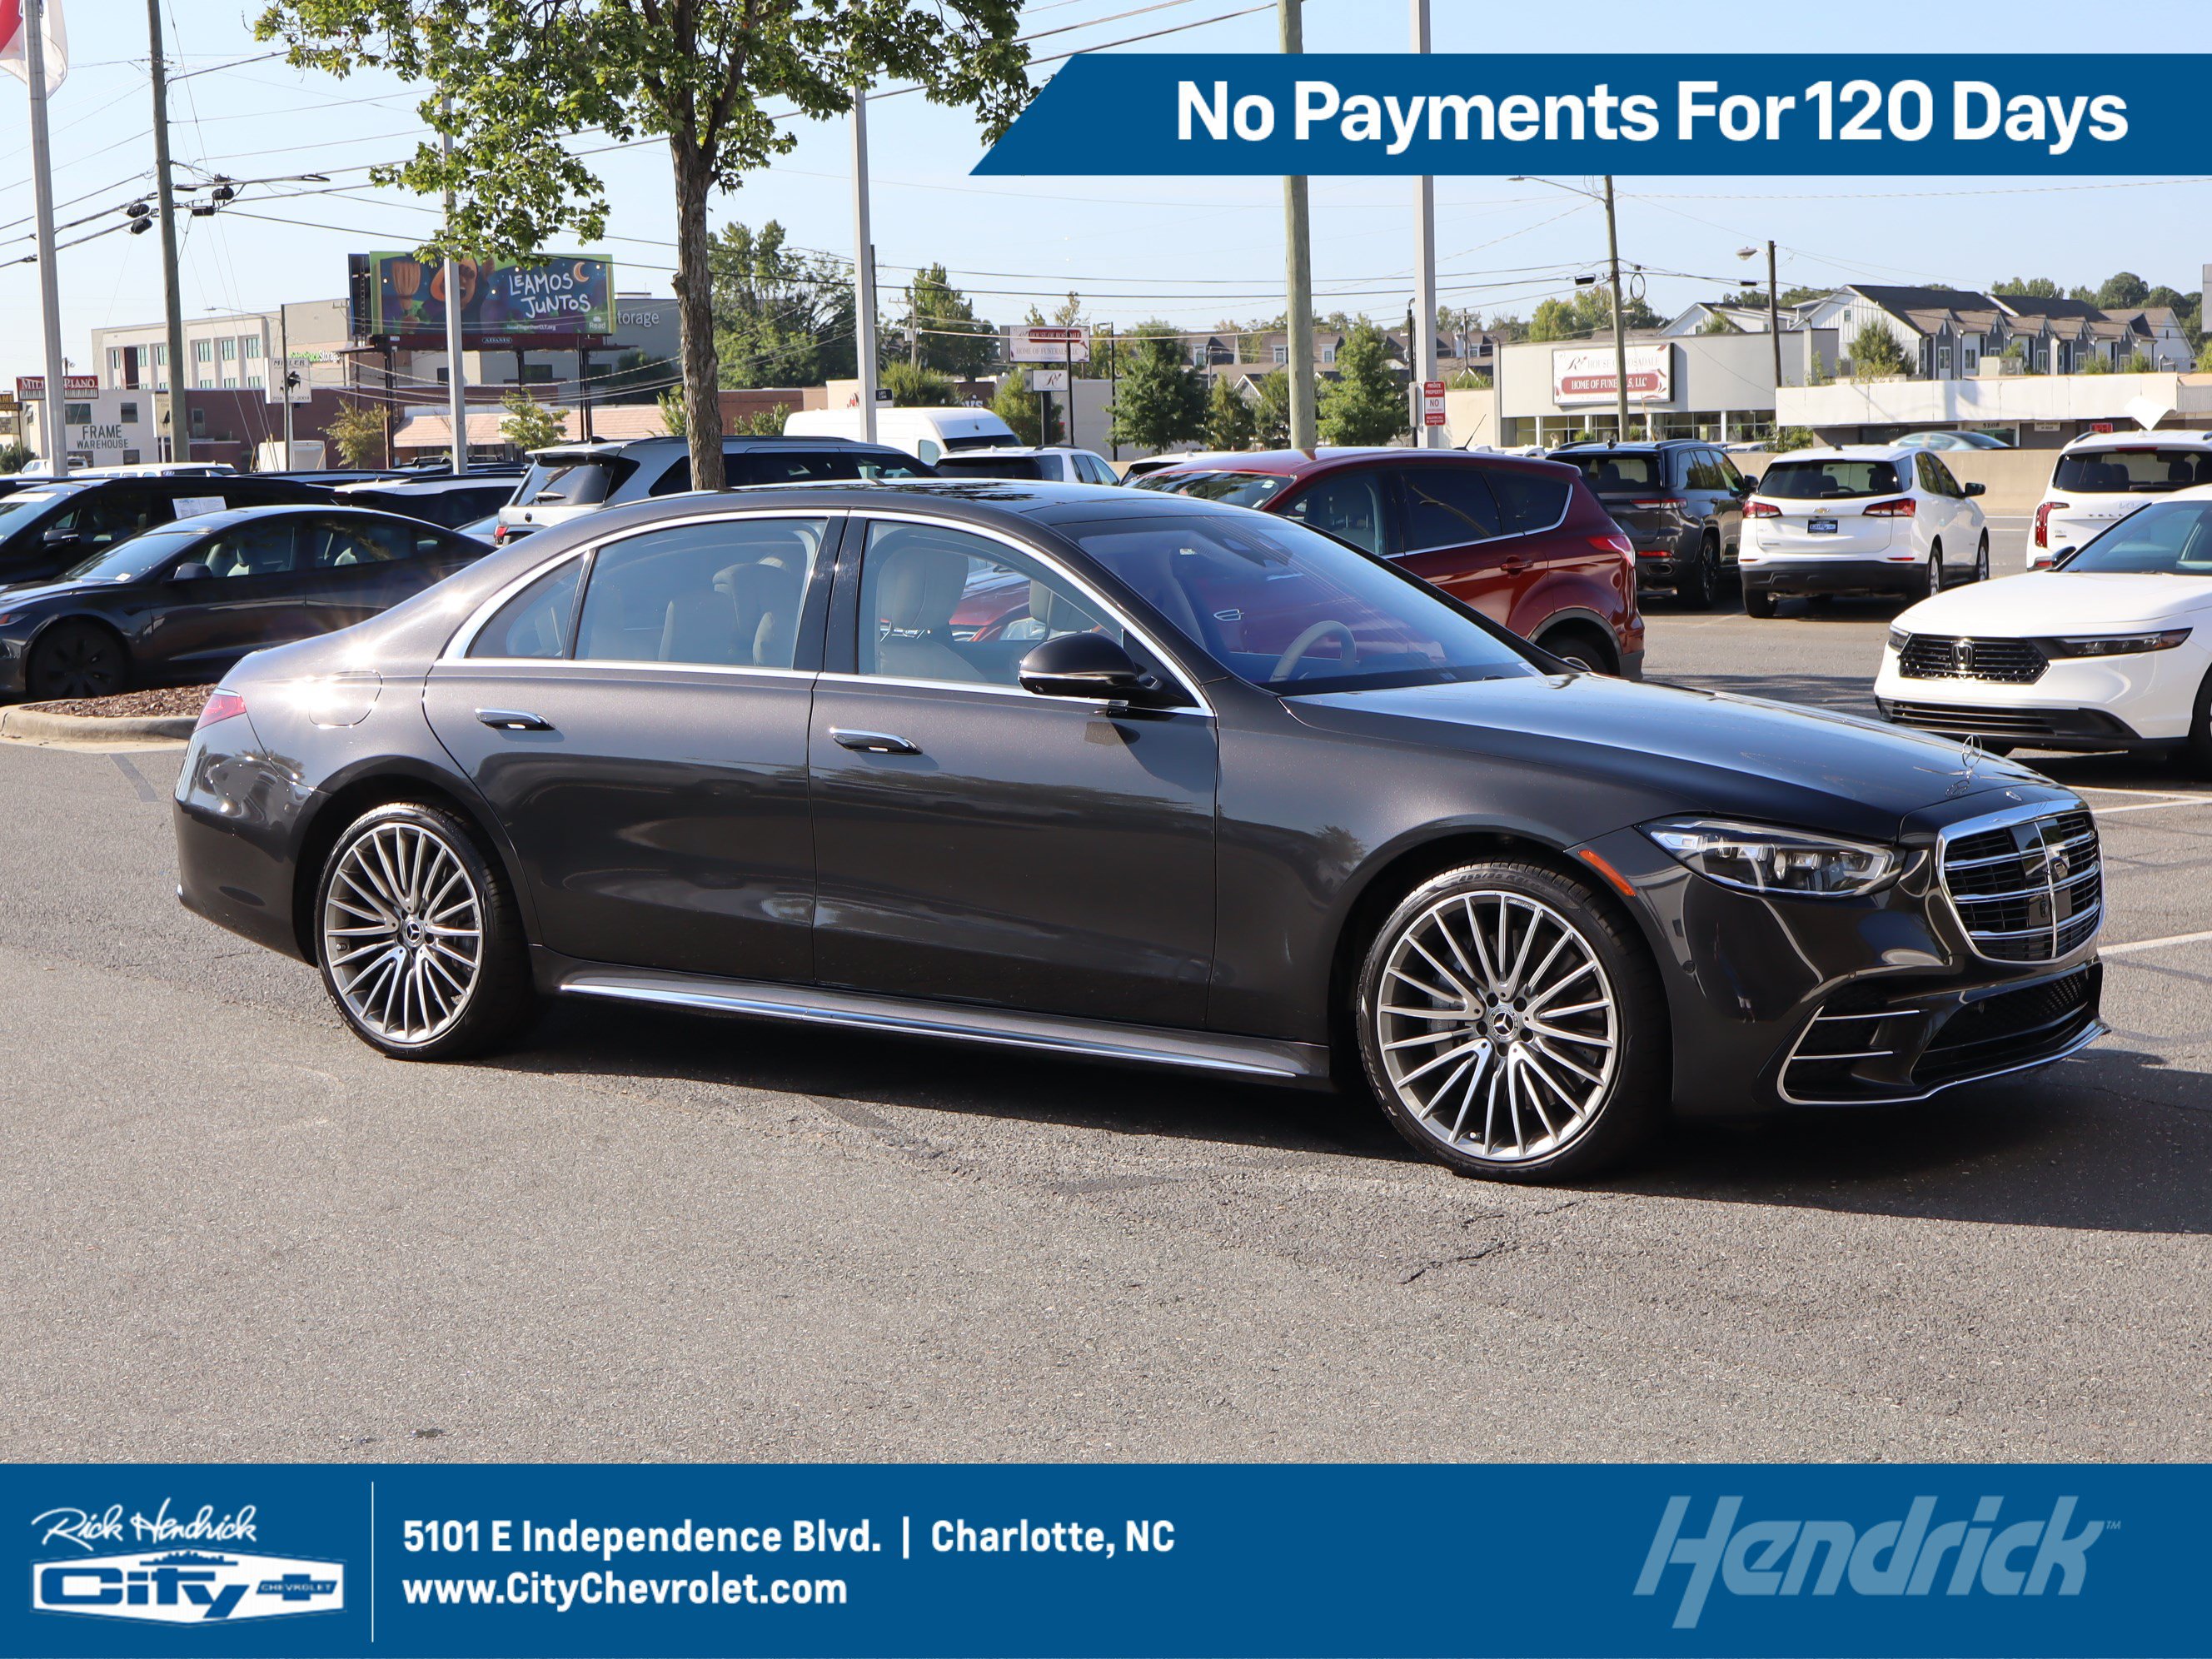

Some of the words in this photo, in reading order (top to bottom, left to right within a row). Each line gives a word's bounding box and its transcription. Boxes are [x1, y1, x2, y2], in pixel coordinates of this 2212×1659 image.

[509, 272, 574, 296] LEAMOS
[617, 311, 660, 328] torage
[273, 359, 305, 367] MILER
[1587, 358, 1611, 369] HOUSE
[63, 377, 95, 389] PIANO
[1571, 379, 1590, 390] HOME
[1590, 379, 1600, 389] OF
[1635, 376, 1647, 387] LLC
[1429, 398, 1440, 407] NO
[82, 425, 122, 441] FRAME
[77, 439, 129, 450] WAREHOUSE
